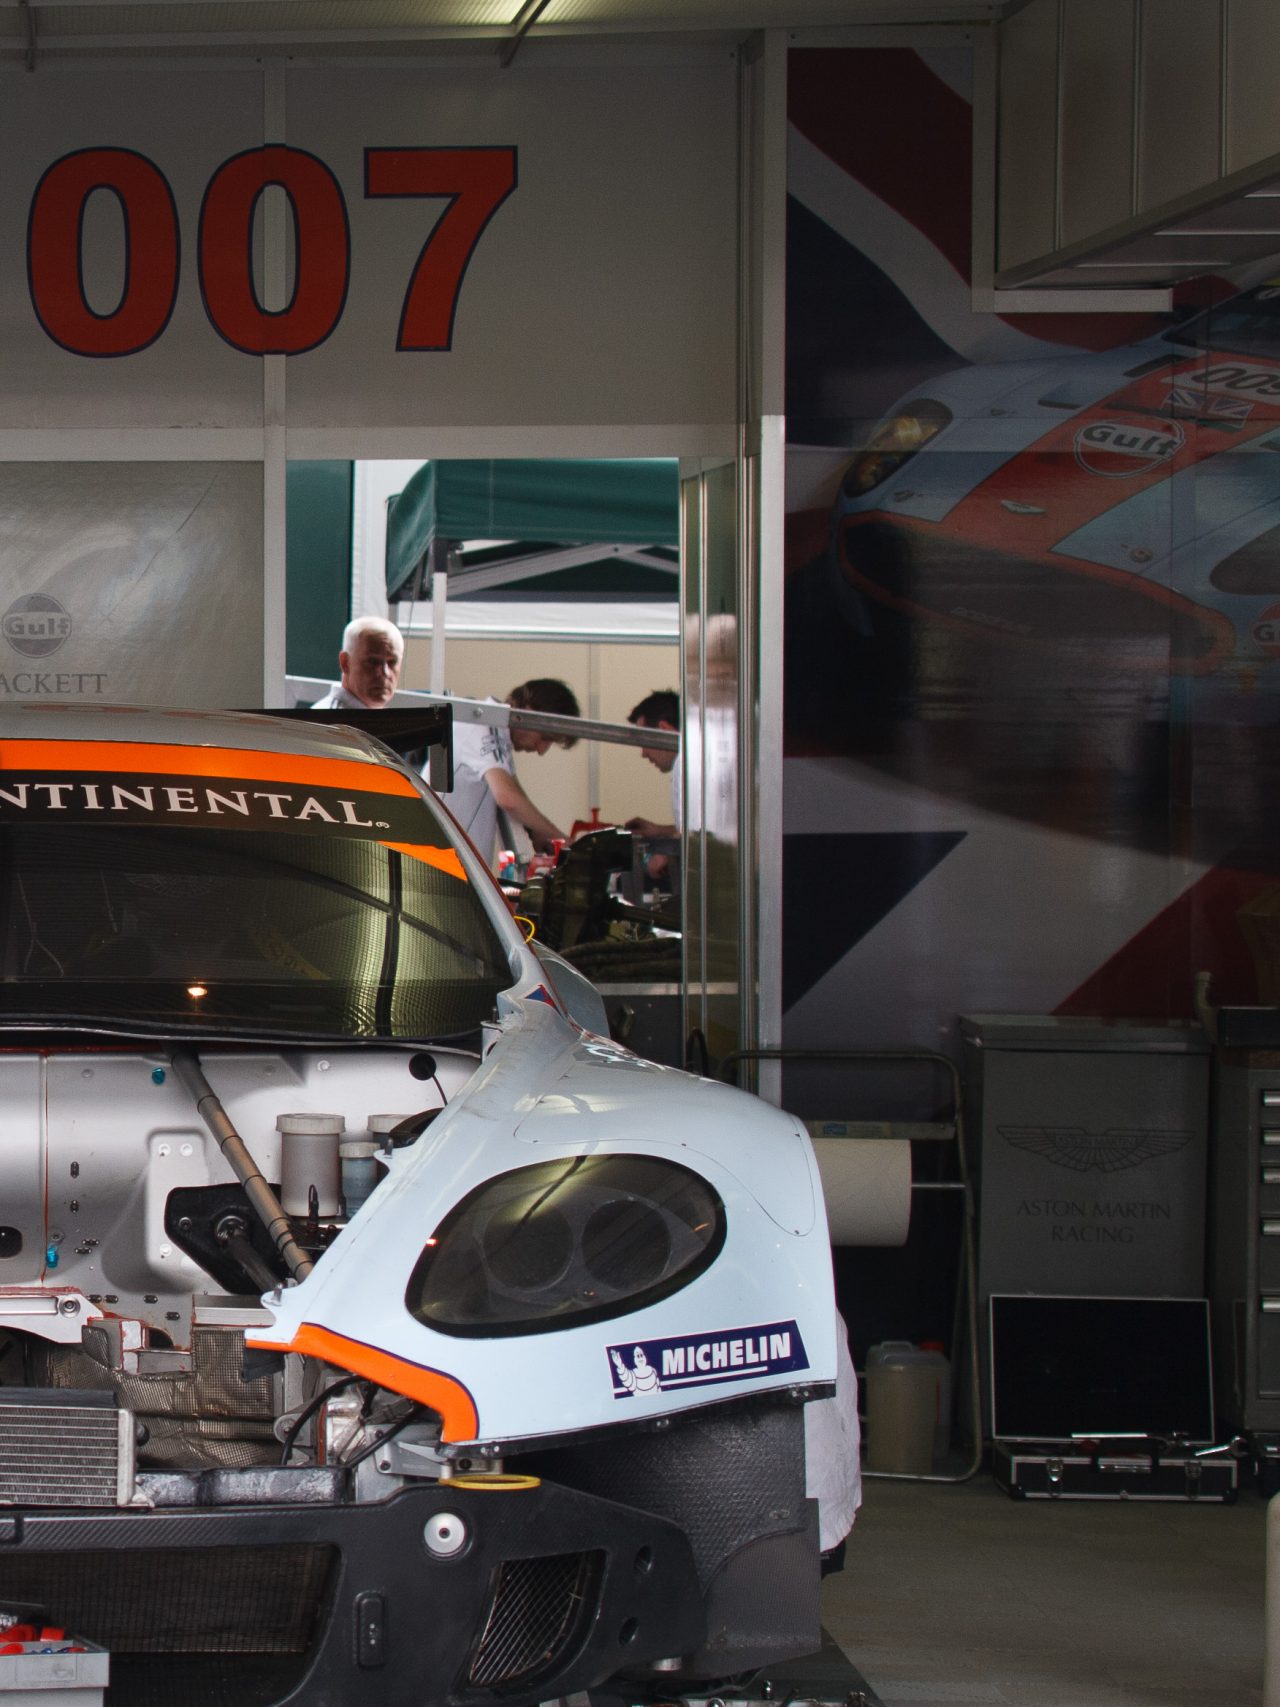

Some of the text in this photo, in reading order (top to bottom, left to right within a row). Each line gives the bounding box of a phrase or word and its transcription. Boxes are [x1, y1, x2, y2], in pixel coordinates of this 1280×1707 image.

[26, 143, 519, 358] 007
[1082, 424, 1177, 455] Gulf
[5, 617, 69, 635] Gulf
[1017, 1200, 1170, 1219] ASTON MARTIN
[1052, 1226, 1134, 1243] RACING
[662, 1332, 791, 1376] MICHELIN
